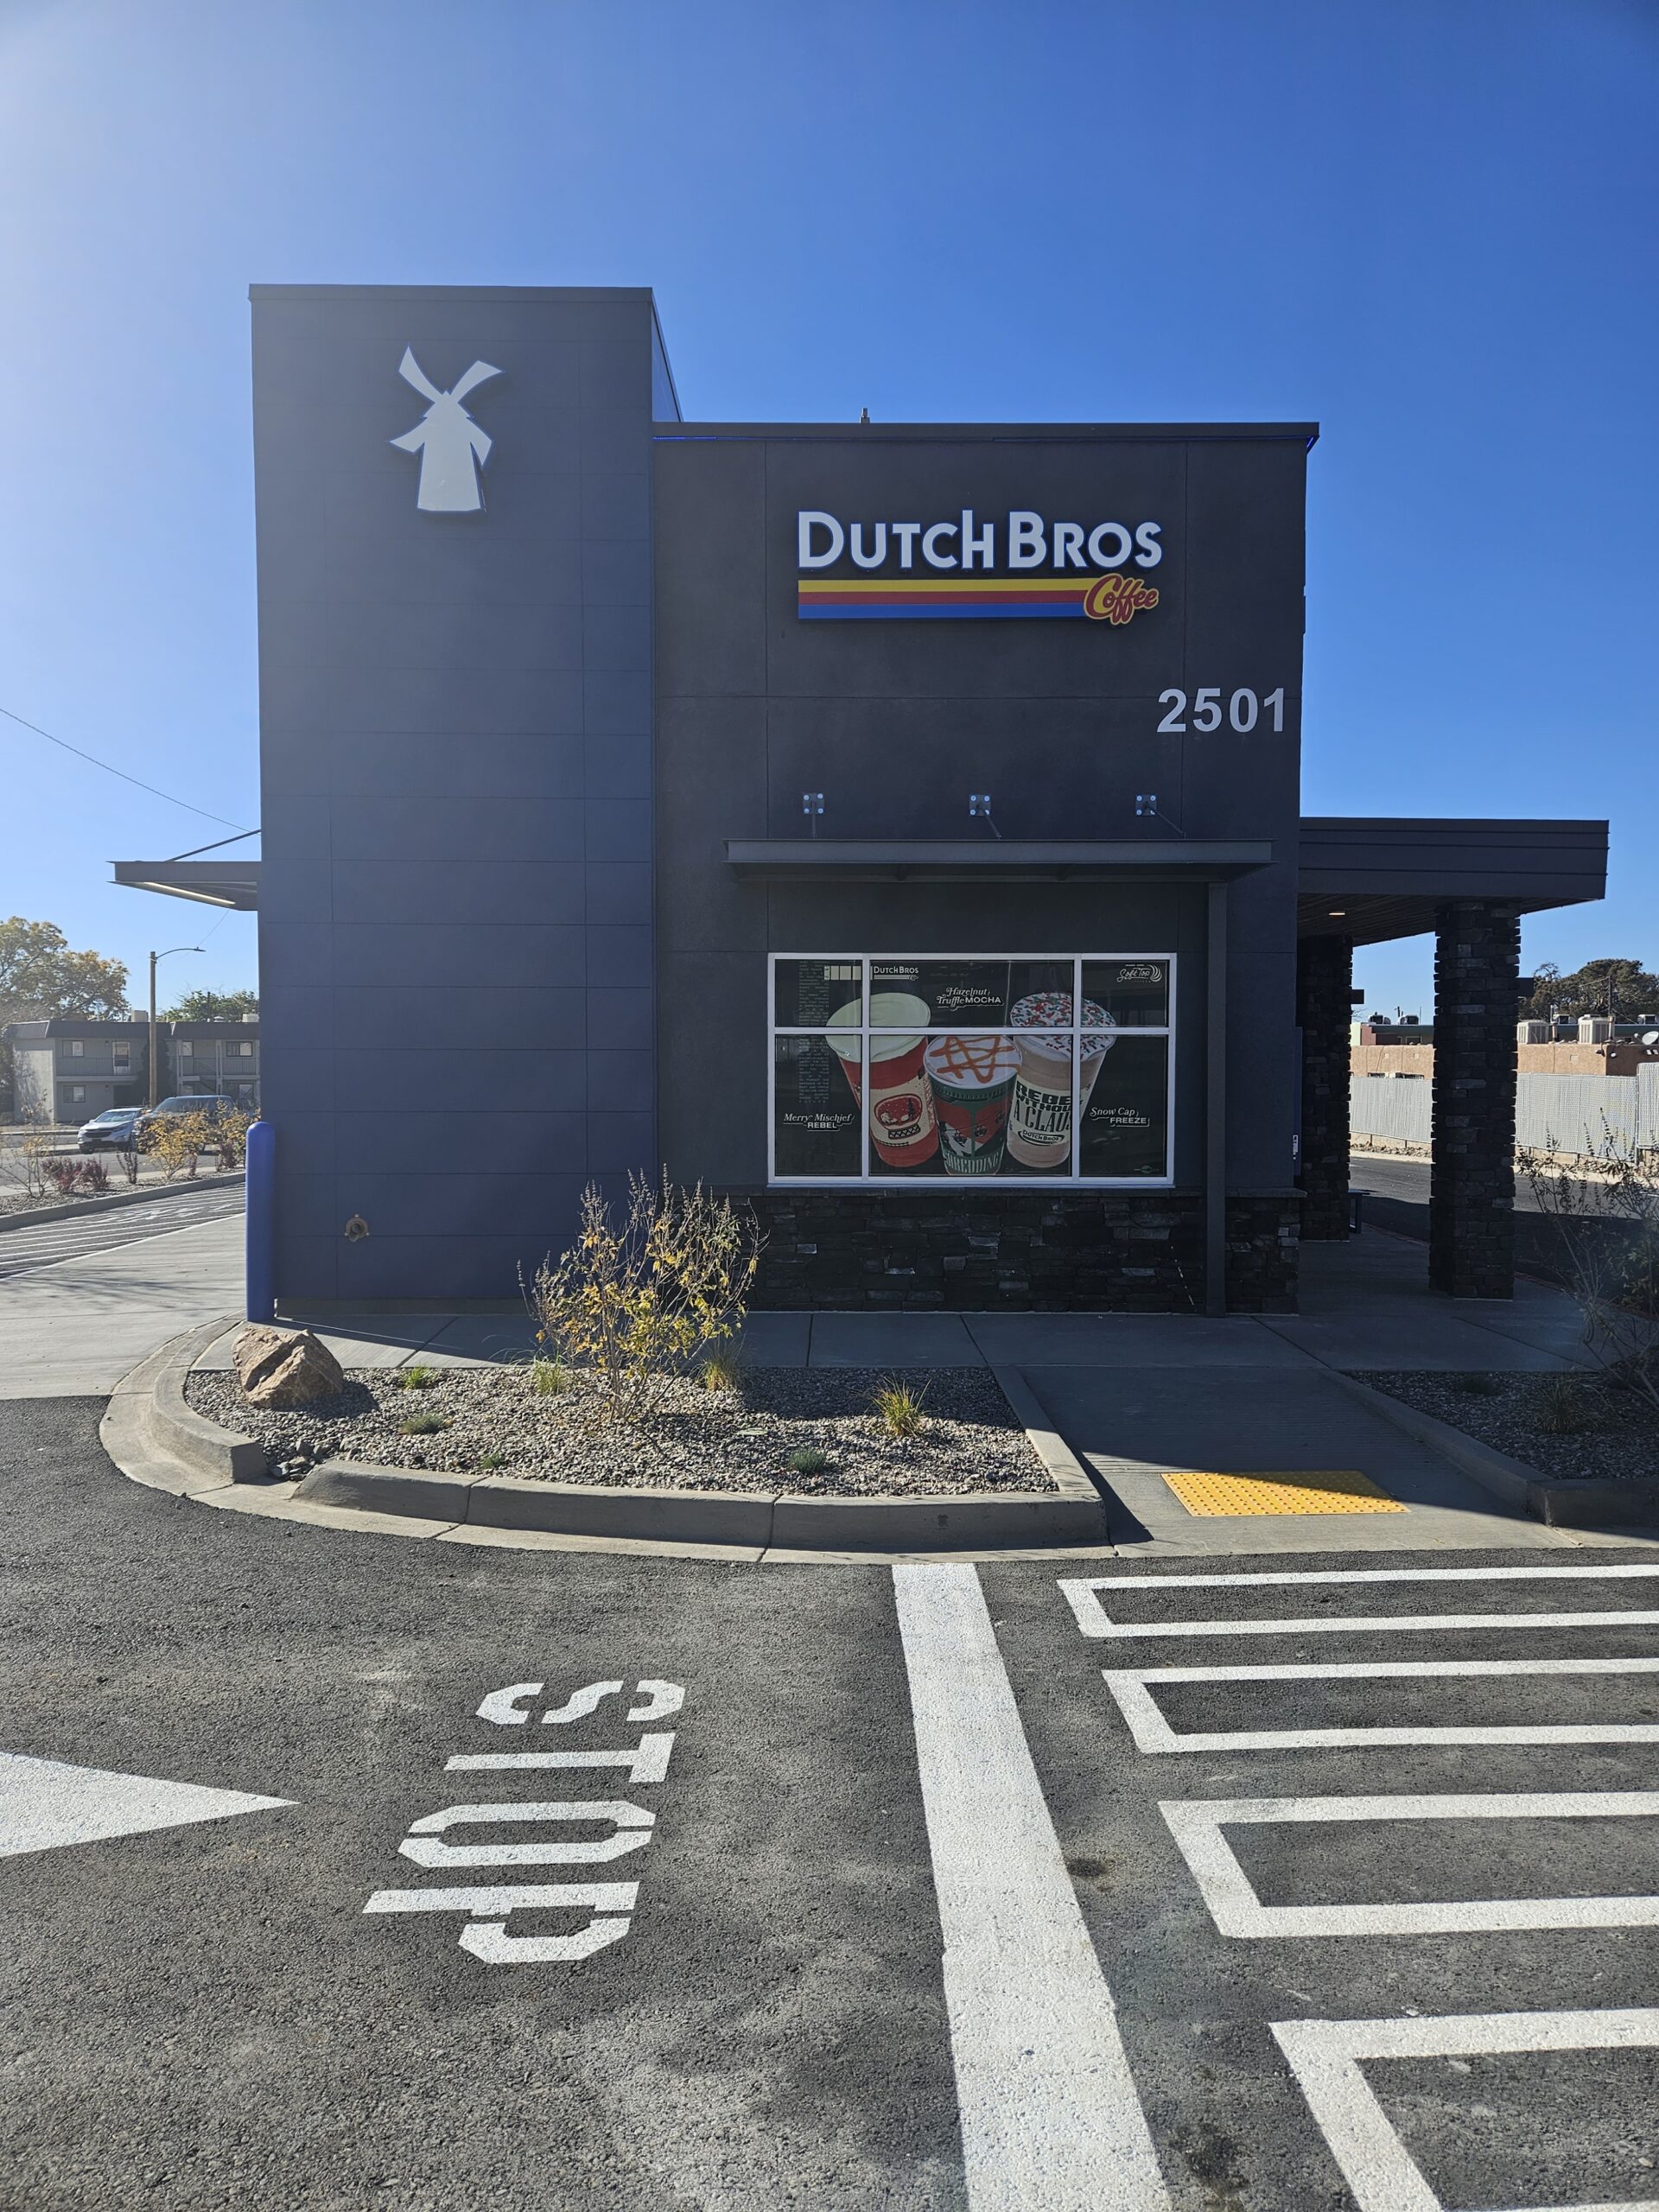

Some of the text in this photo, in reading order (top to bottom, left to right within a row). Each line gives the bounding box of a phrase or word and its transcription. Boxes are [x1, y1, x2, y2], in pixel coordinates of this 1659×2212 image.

[798, 509, 1163, 569] DUTCH BROS
[1085, 574, 1159, 625] Coffee
[1156, 687, 1285, 733] 2501
[936, 995, 965, 1007] Truffle
[945, 987, 988, 996] Hazelnut
[1015, 1090, 1078, 1113] WITHOU
[1016, 1080, 1071, 1105] REBE
[783, 1113, 852, 1123] Merry Mischief
[1013, 1098, 1020, 1122] A
[1089, 1107, 1135, 1117] Snow Cap
[362, 1680, 686, 1965] STOP
